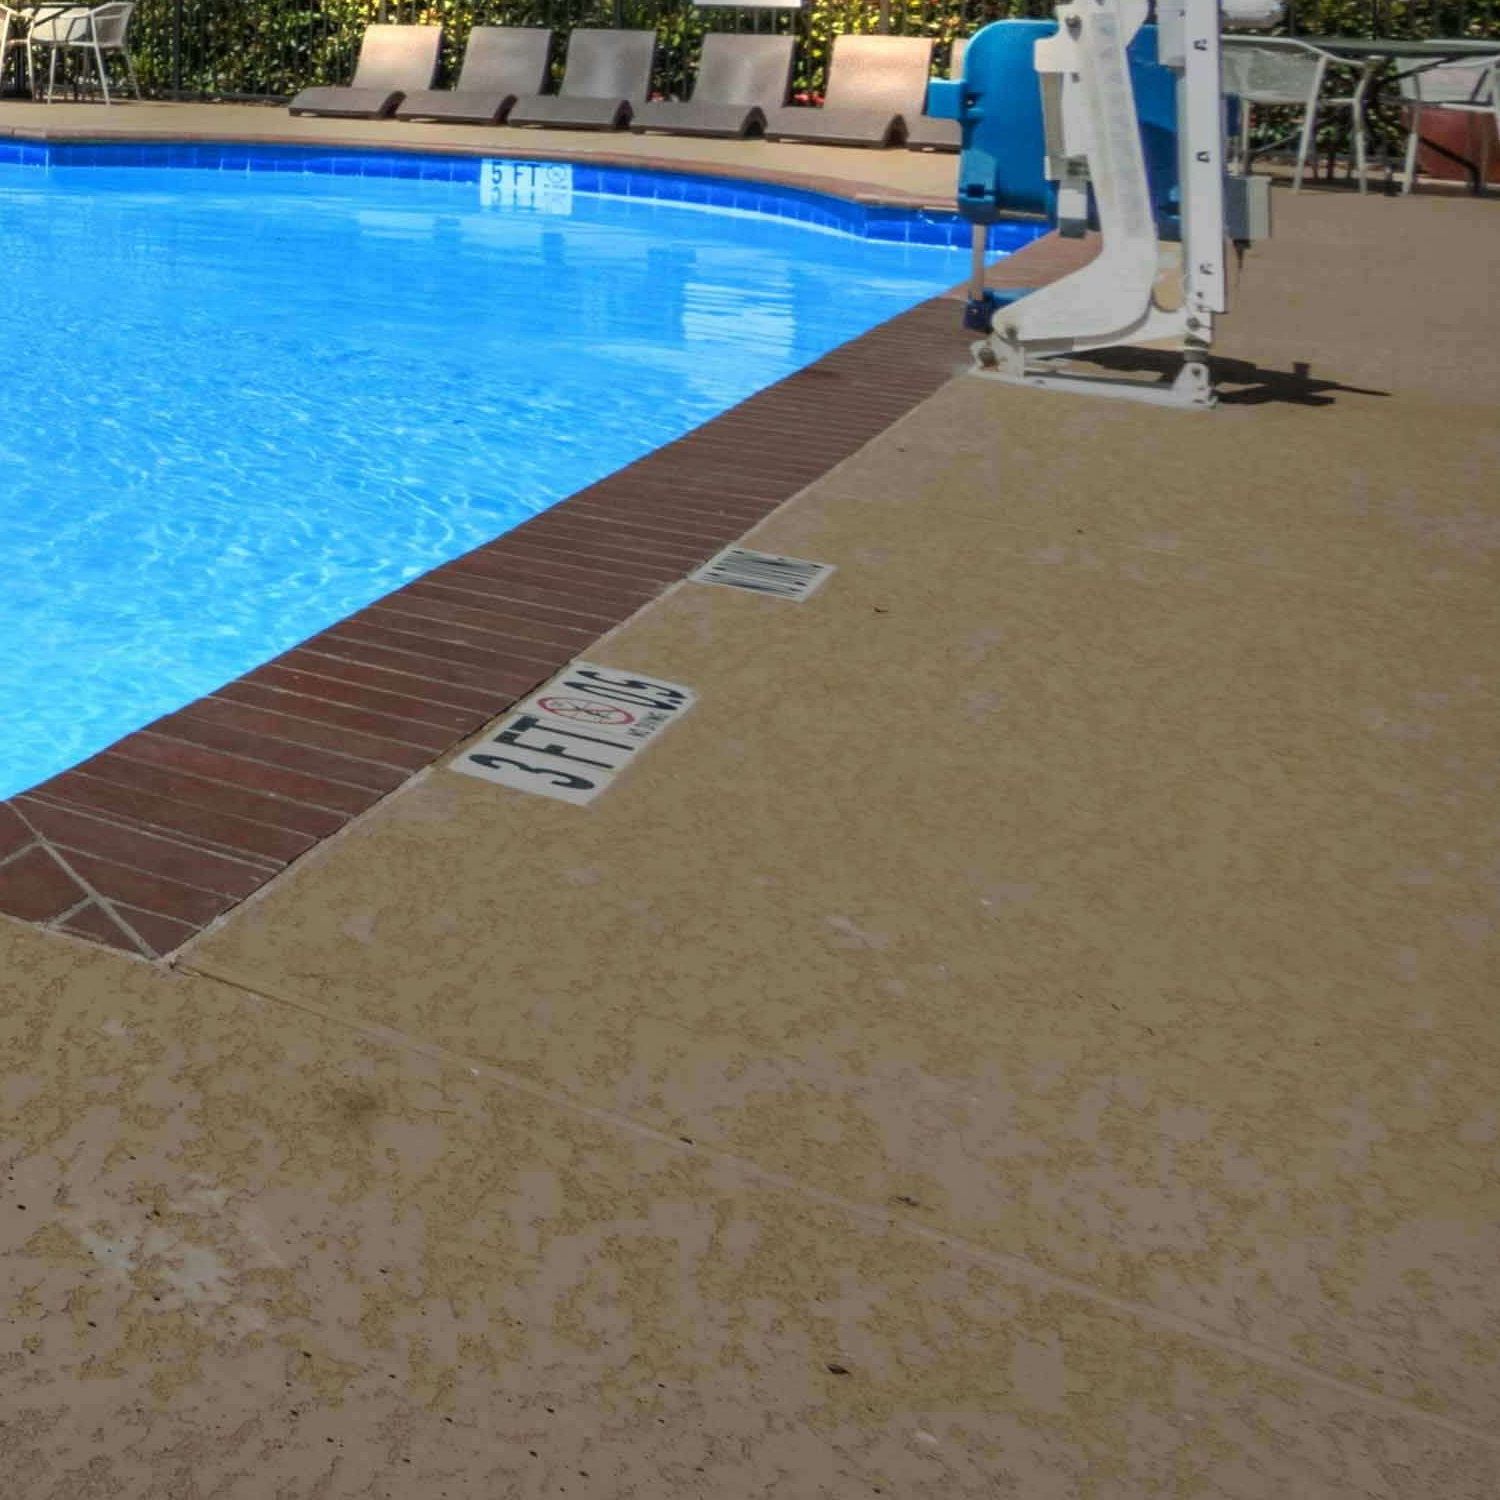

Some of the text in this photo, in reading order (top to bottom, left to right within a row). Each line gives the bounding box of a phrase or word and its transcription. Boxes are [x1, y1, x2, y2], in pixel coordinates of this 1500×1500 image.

[491, 161, 541, 187] 5 FT
[492, 714, 636, 770] FT
[468, 753, 596, 791] 3
